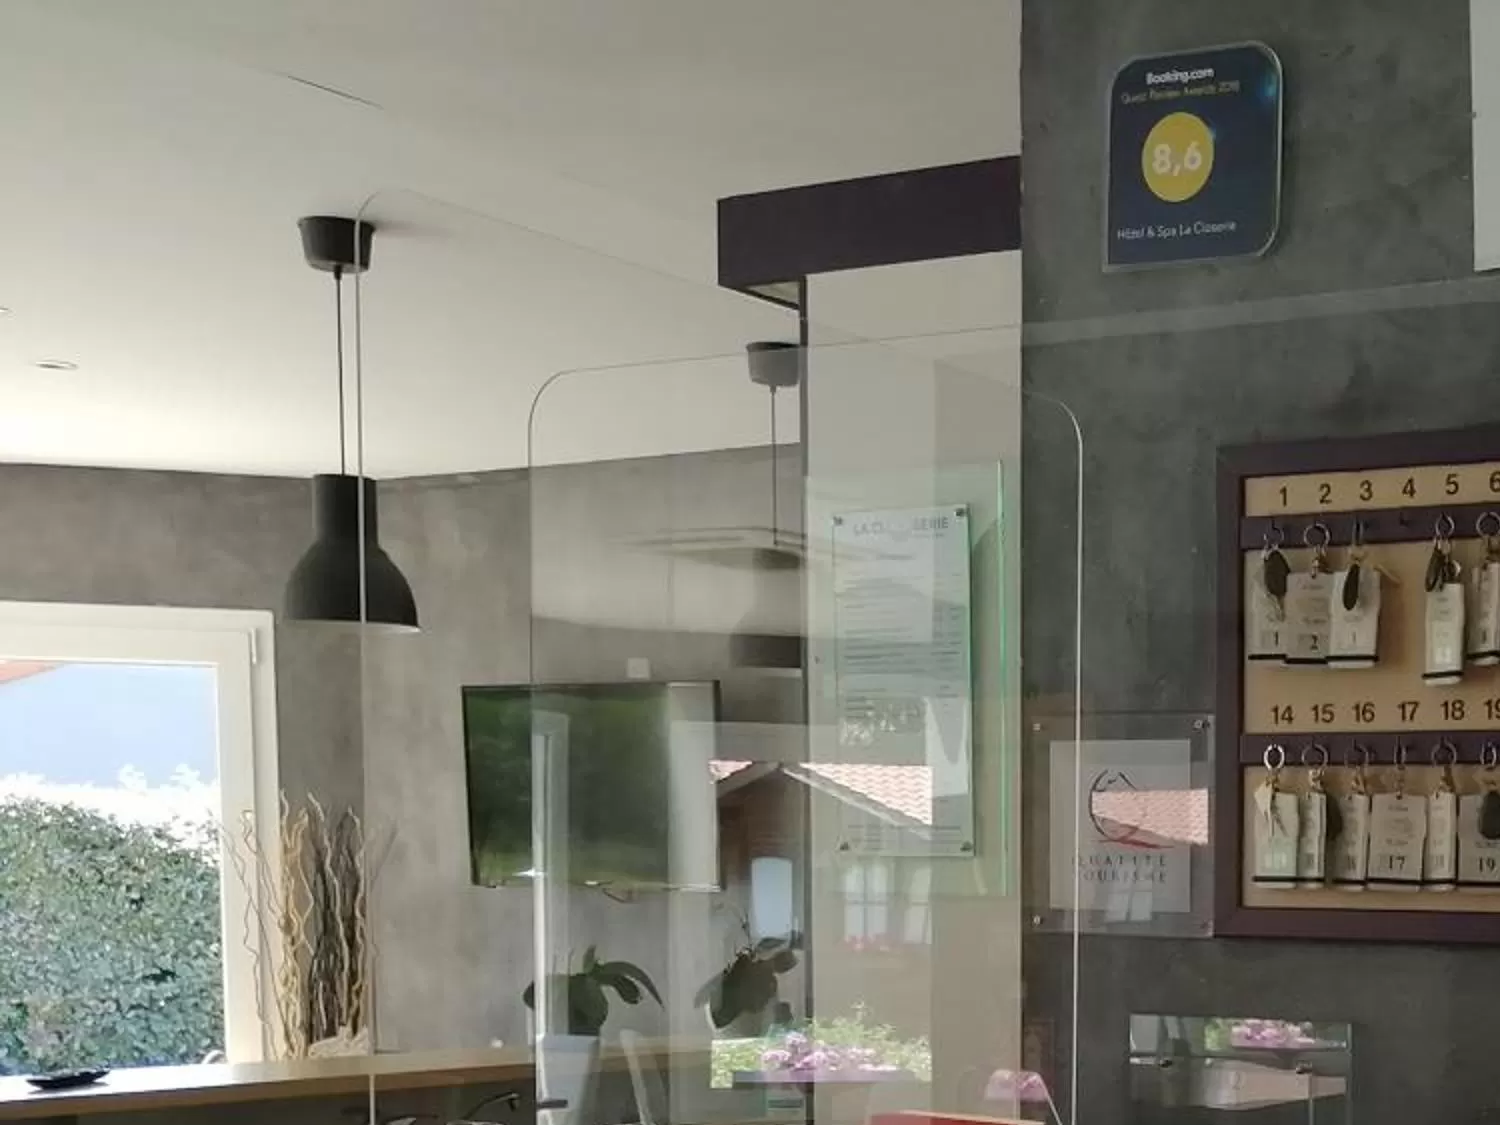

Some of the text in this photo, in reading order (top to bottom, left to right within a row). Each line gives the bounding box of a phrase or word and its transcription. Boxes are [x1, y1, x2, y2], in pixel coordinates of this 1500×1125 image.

[1152, 141, 1202, 176] 8,6
[1280, 487, 1288, 507] 1
[1319, 483, 1332, 504] 2
[1360, 480, 1373, 501] 3
[1402, 477, 1416, 497] 4
[1445, 474, 1459, 495] 5
[1271, 705, 1294, 725] 14
[1311, 703, 1335, 723] 15
[1352, 703, 1375, 723] 16
[1397, 701, 1420, 722] 17
[1441, 700, 1465, 721] 18
[1388, 856, 1406, 870] 17
[1478, 858, 1496, 873] 19
